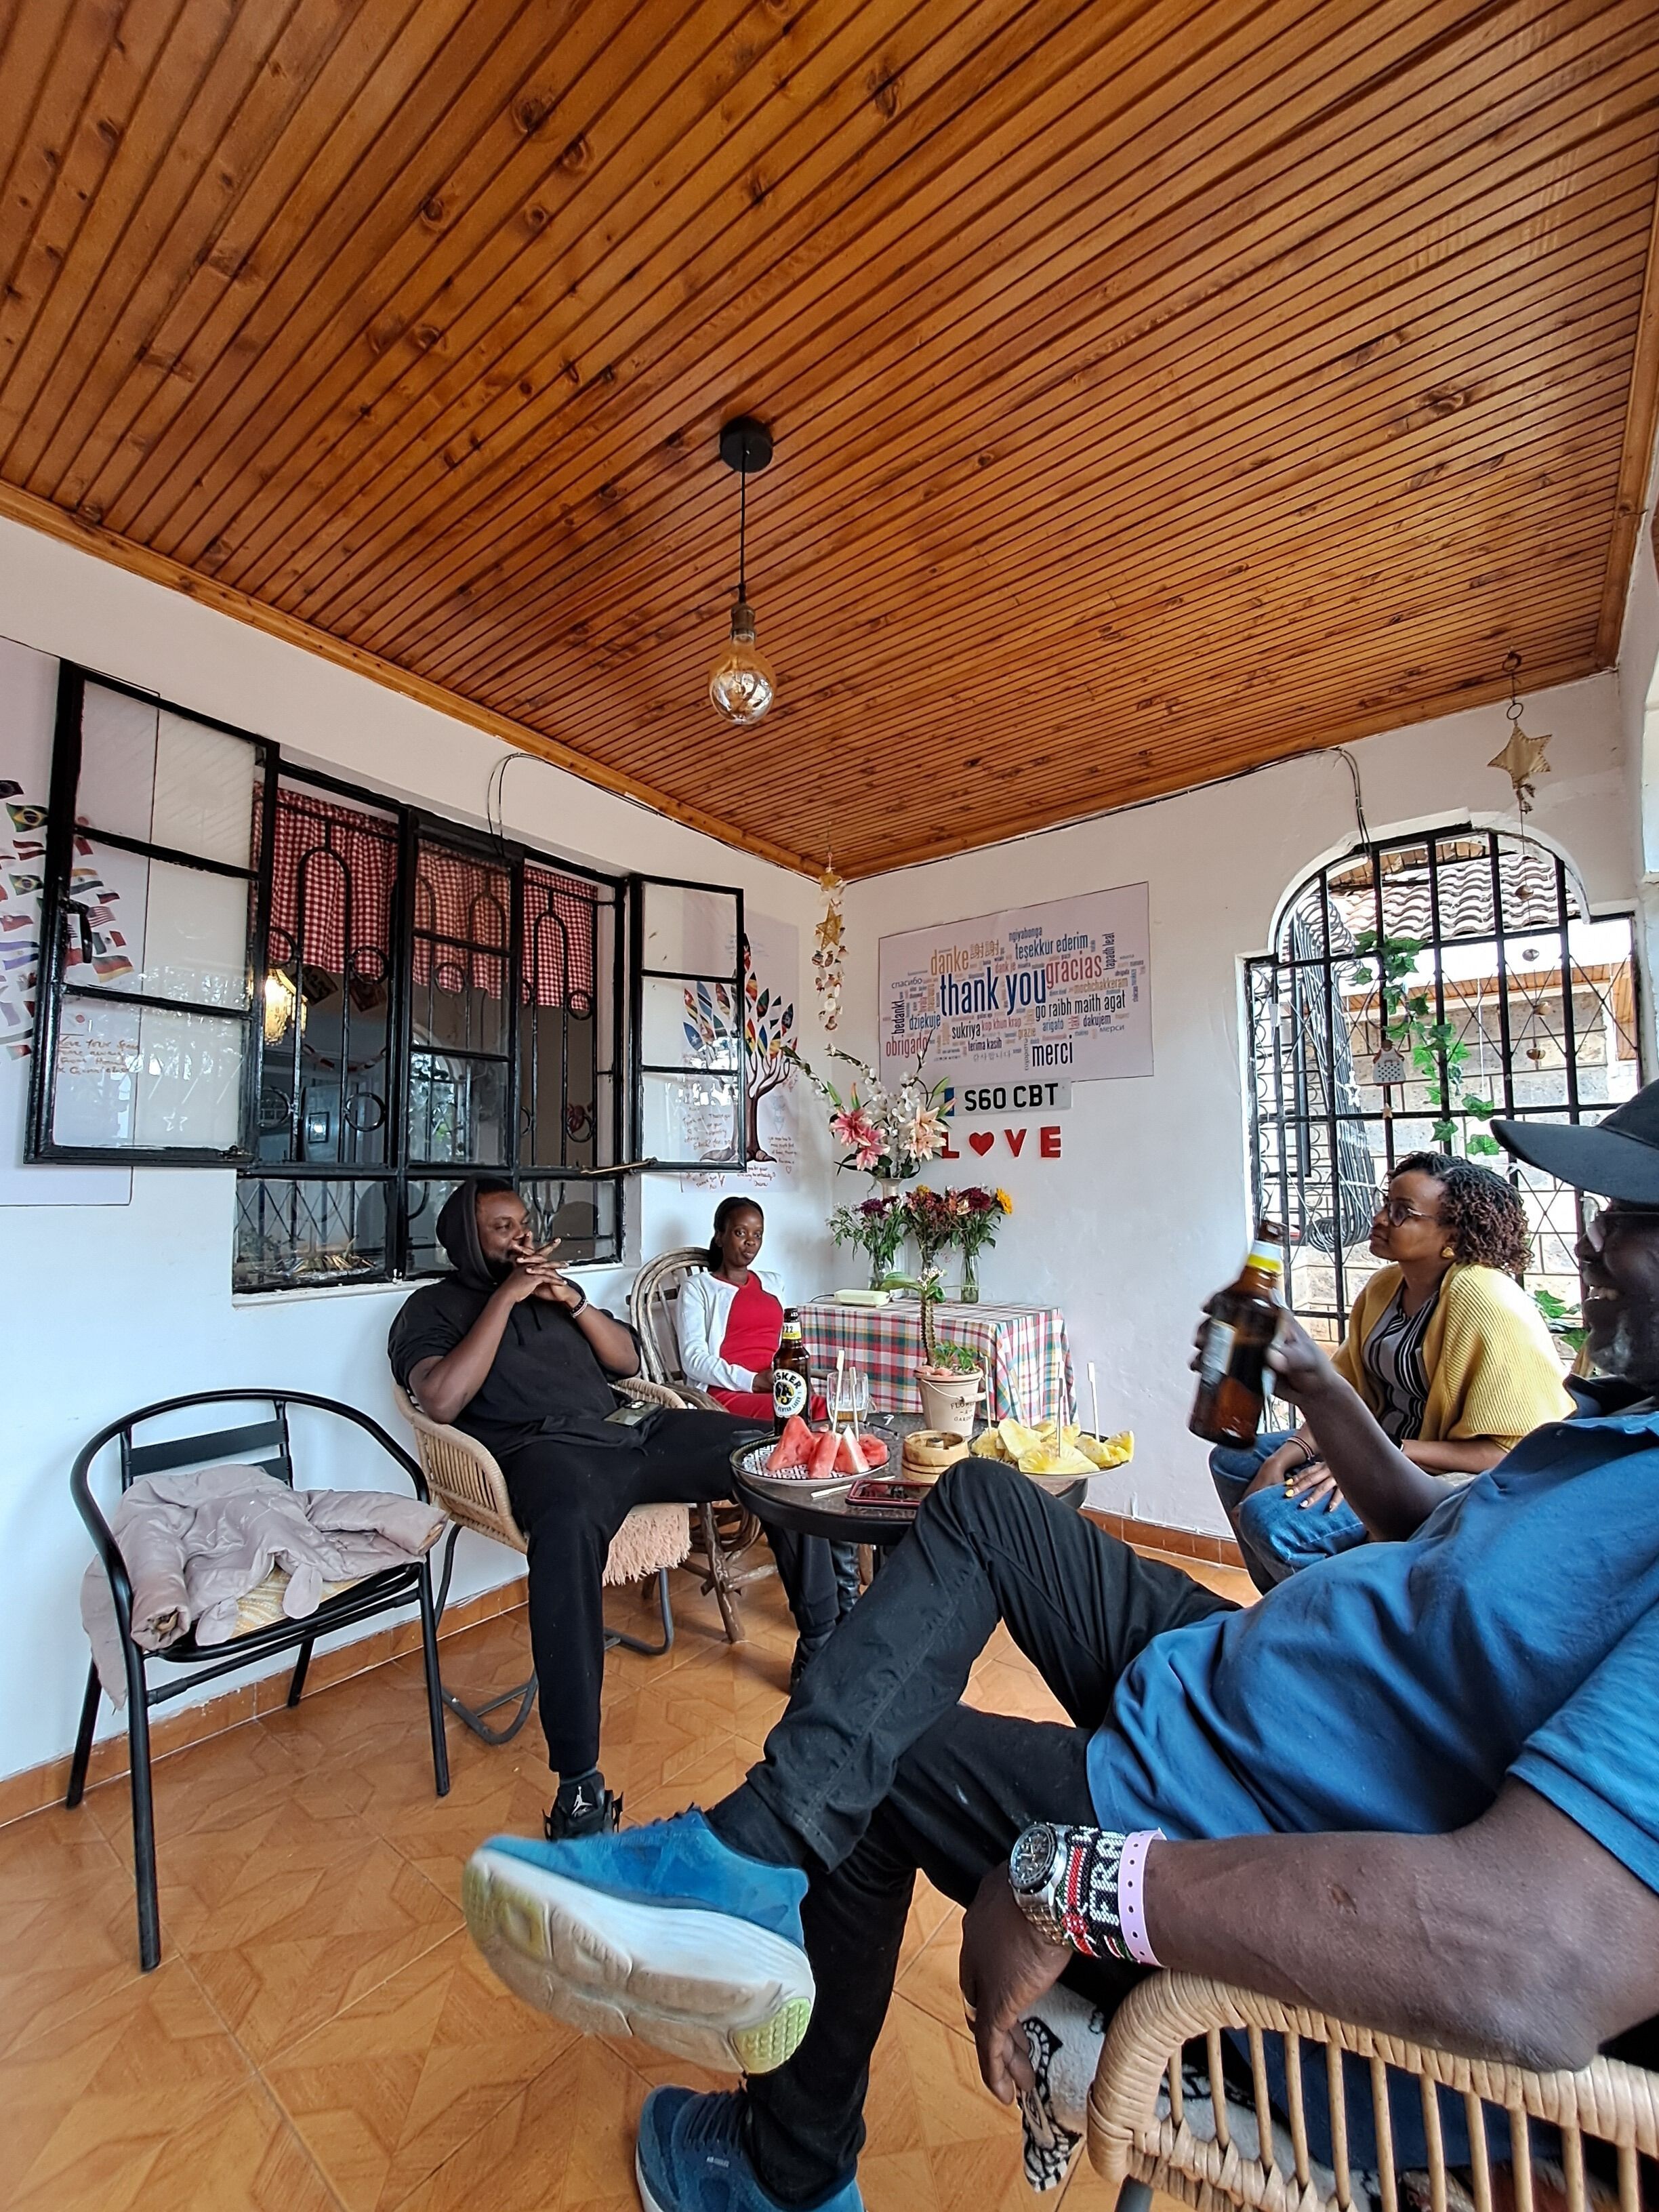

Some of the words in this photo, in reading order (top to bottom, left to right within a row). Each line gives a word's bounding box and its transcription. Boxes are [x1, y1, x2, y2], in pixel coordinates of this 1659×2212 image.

[1057, 931, 1088, 953] ederim
[930, 945, 969, 976] danke
[1046, 950, 1103, 989] gracias
[891, 977, 922, 989] спасибо
[940, 967, 1000, 1017] thank
[1006, 968, 1046, 1016] you
[1036, 1005, 1046, 1022] go
[1049, 998, 1072, 1017] raibh
[1075, 994, 1101, 1015] maith
[1104, 989, 1126, 1013] agat
[886, 1031, 928, 1059] obrigado
[952, 1021, 981, 1040] sukriya
[1032, 1035, 1073, 1067] merci
[964, 1088, 1006, 1111] S60
[1013, 1083, 1059, 1108] CBT
[1089, 1831, 1126, 1927] FRA
